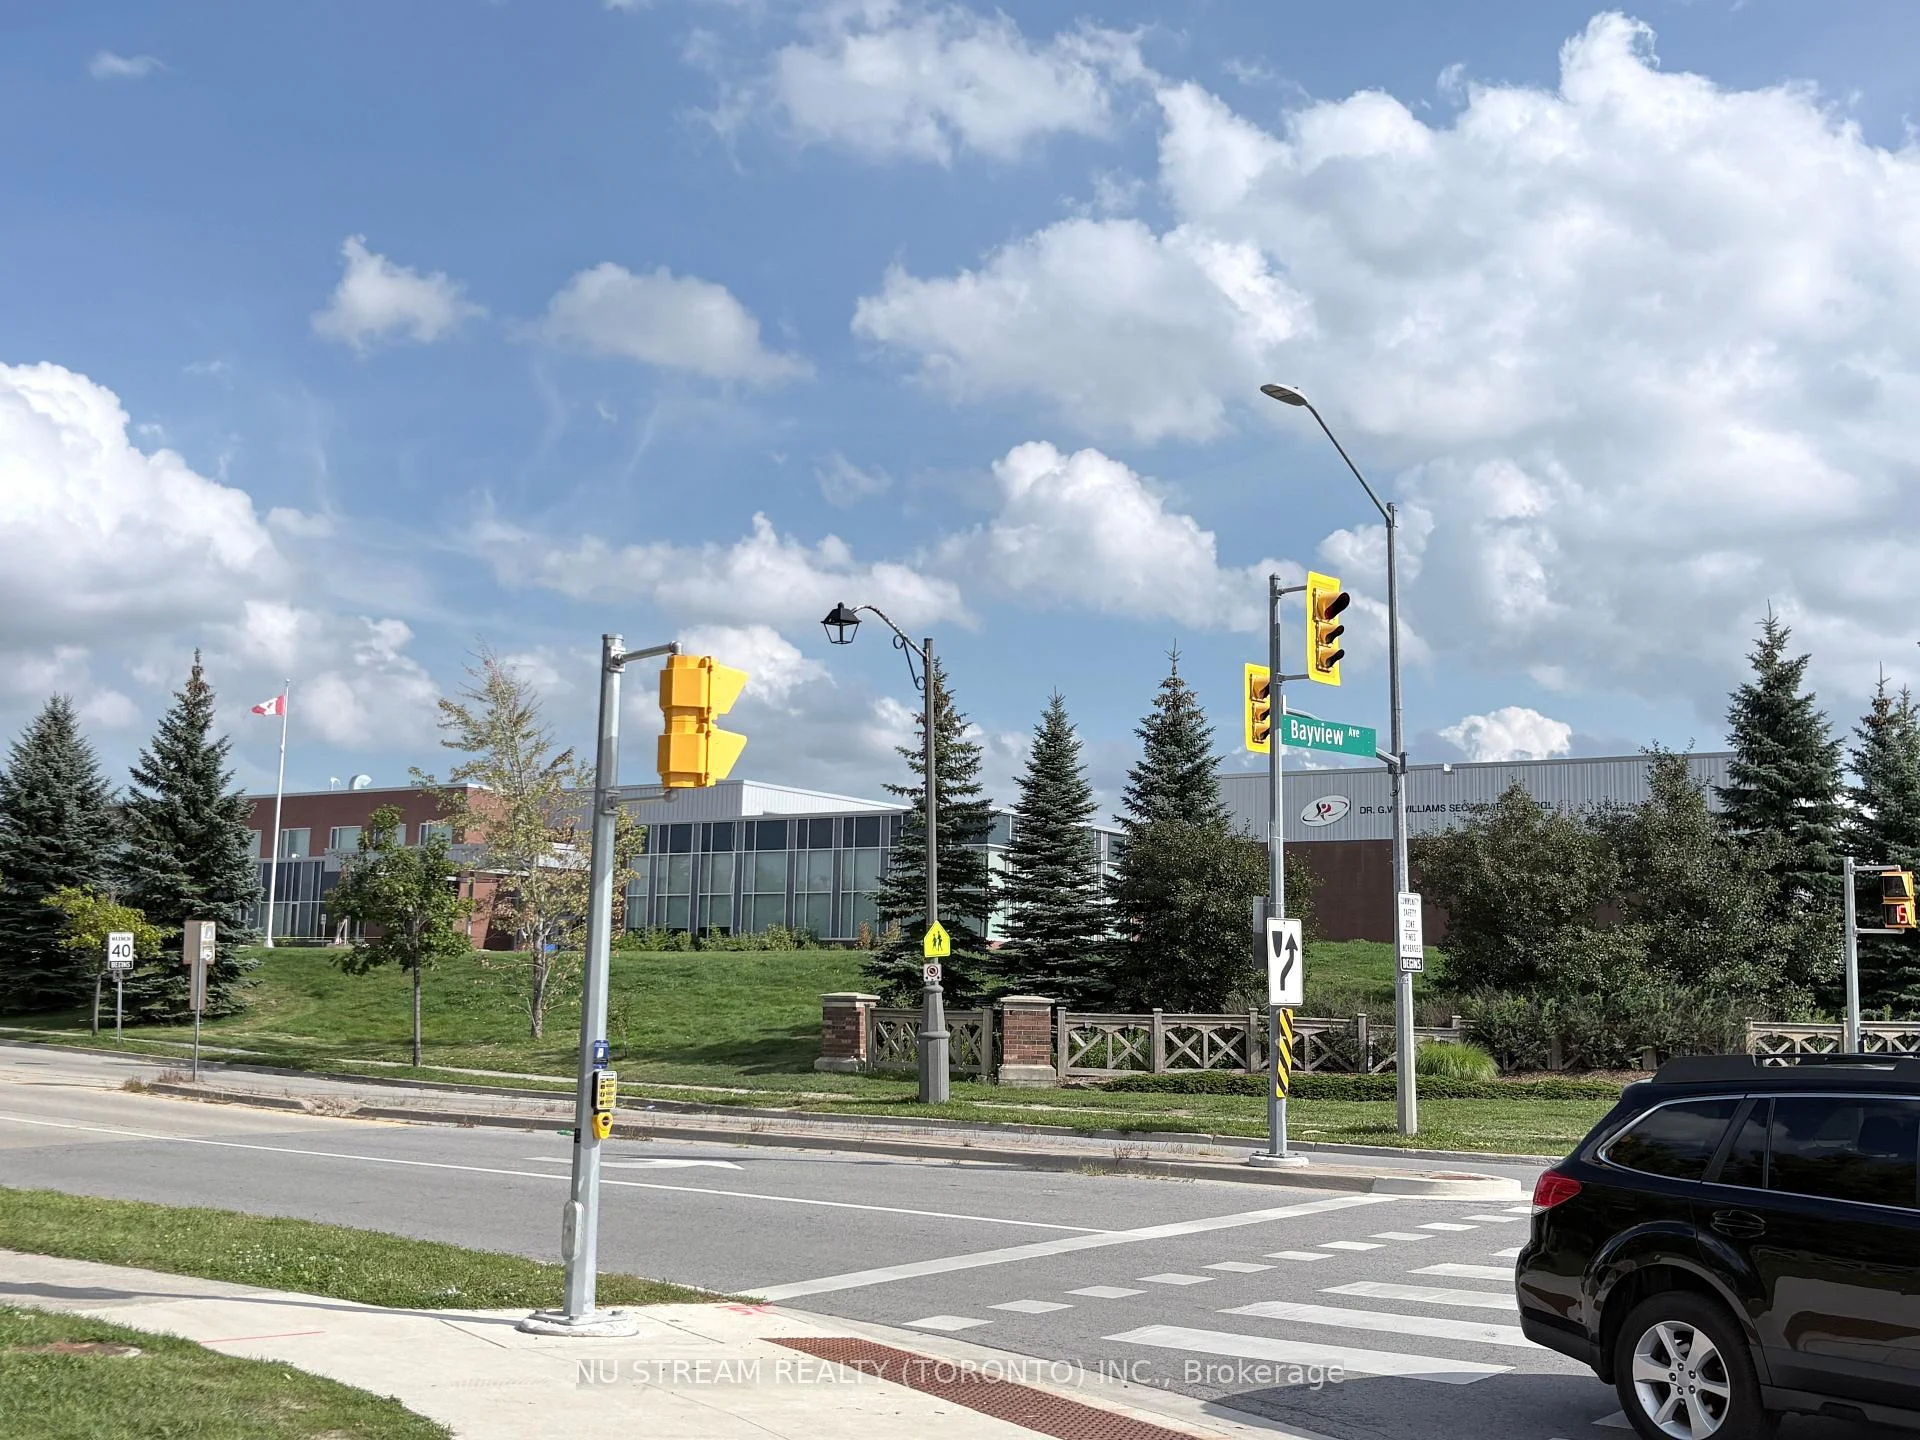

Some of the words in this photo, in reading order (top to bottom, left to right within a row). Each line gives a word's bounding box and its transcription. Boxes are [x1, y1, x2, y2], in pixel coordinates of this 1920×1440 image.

[1290, 719, 1344, 746] Bayview
[1348, 727, 1360, 738] Ave
[1359, 806, 1375, 815] DR.
[112, 944, 130, 957] 40
[1403, 958, 1421, 969] BEGINS
